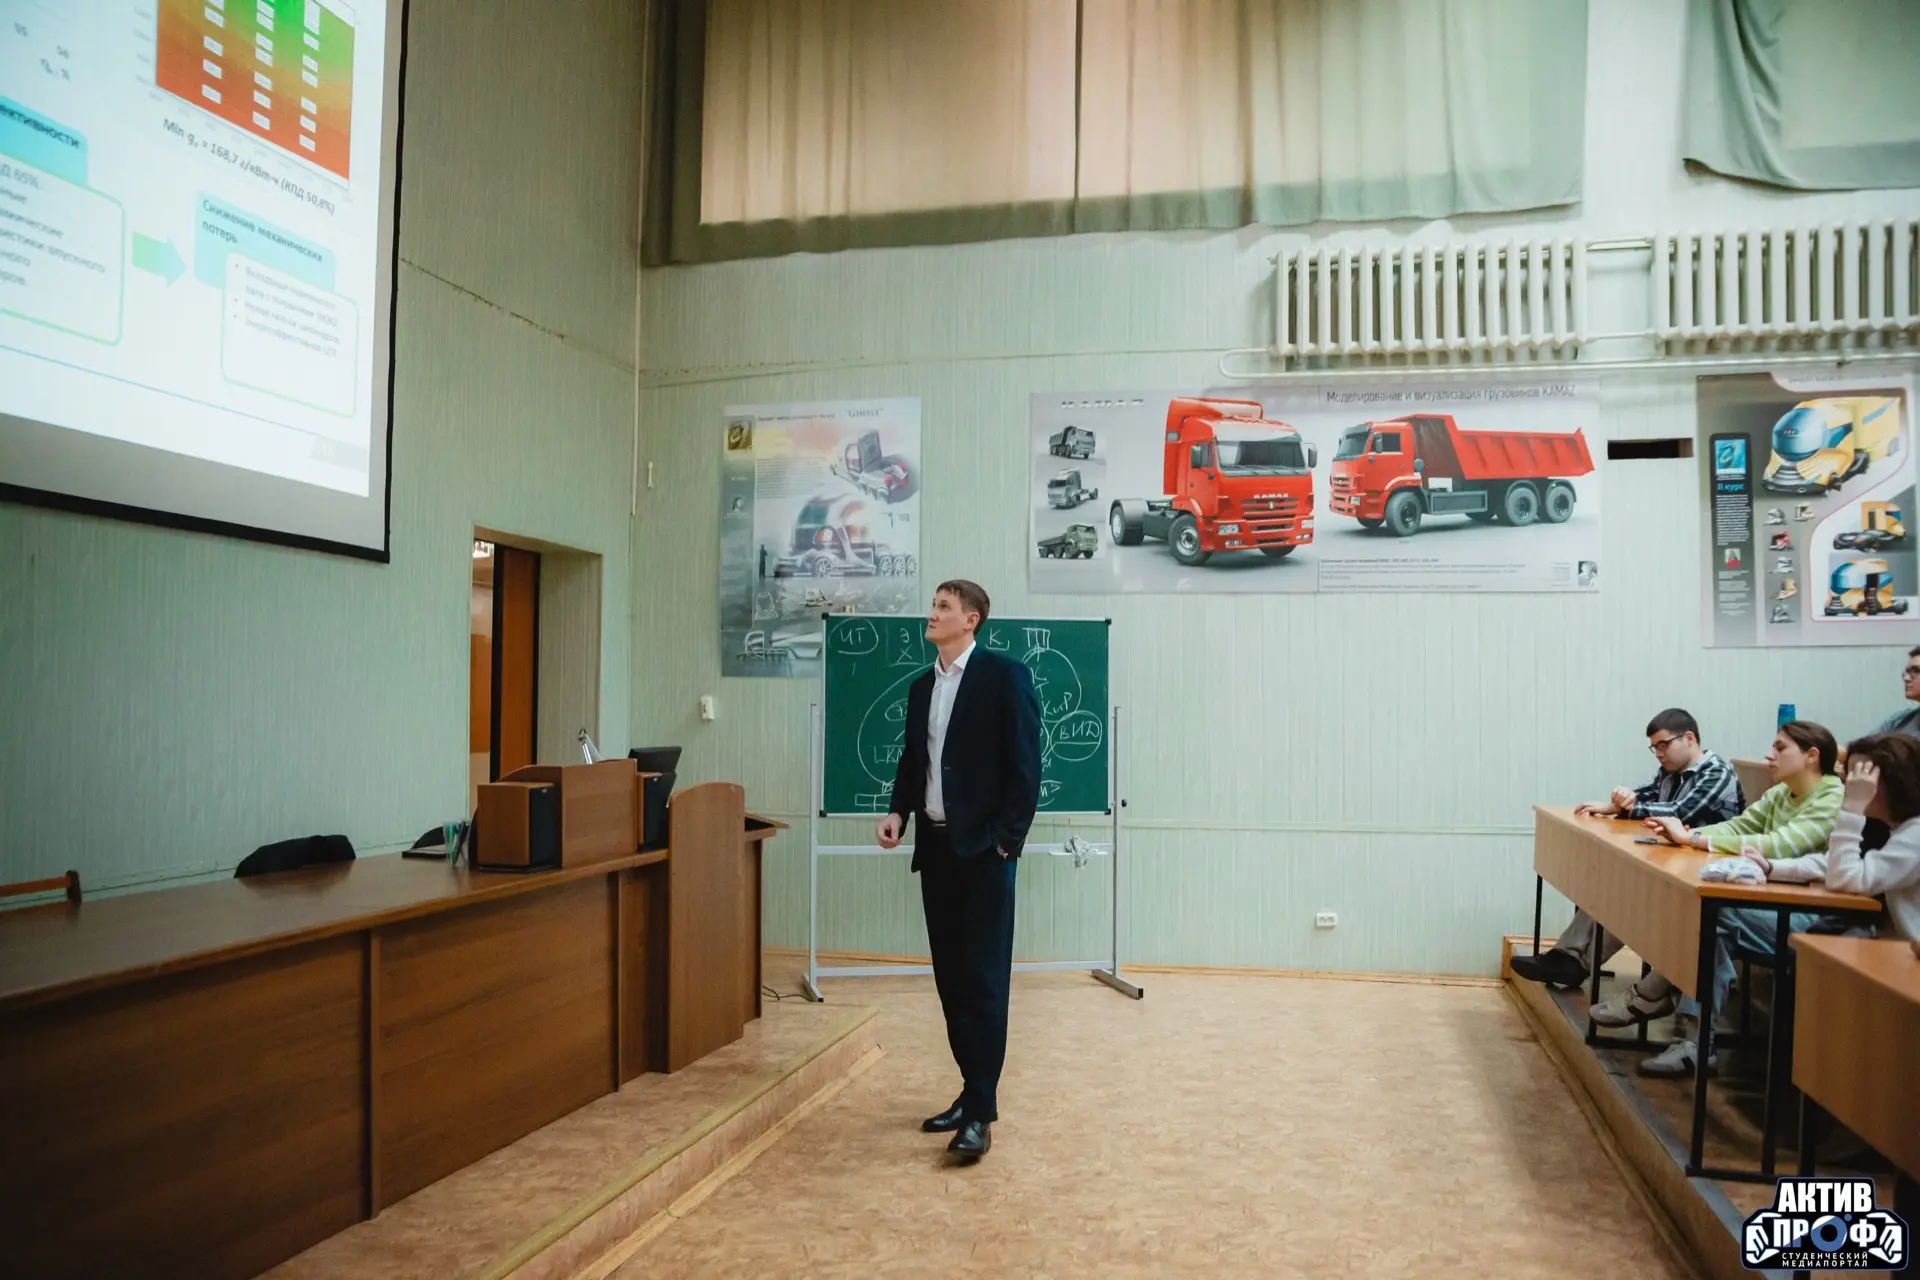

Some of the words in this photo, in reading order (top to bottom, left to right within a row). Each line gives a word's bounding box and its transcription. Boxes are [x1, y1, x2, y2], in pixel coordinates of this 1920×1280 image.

[210, 143, 239, 165] 168,7
[202, 200, 257, 233] Снижение
[256, 225, 324, 262] механических
[202, 220, 239, 245] потерь
[1327, 391, 1403, 403] Моделирование
[1415, 388, 1481, 402] визуализация
[1484, 387, 1540, 401] грузовиков
